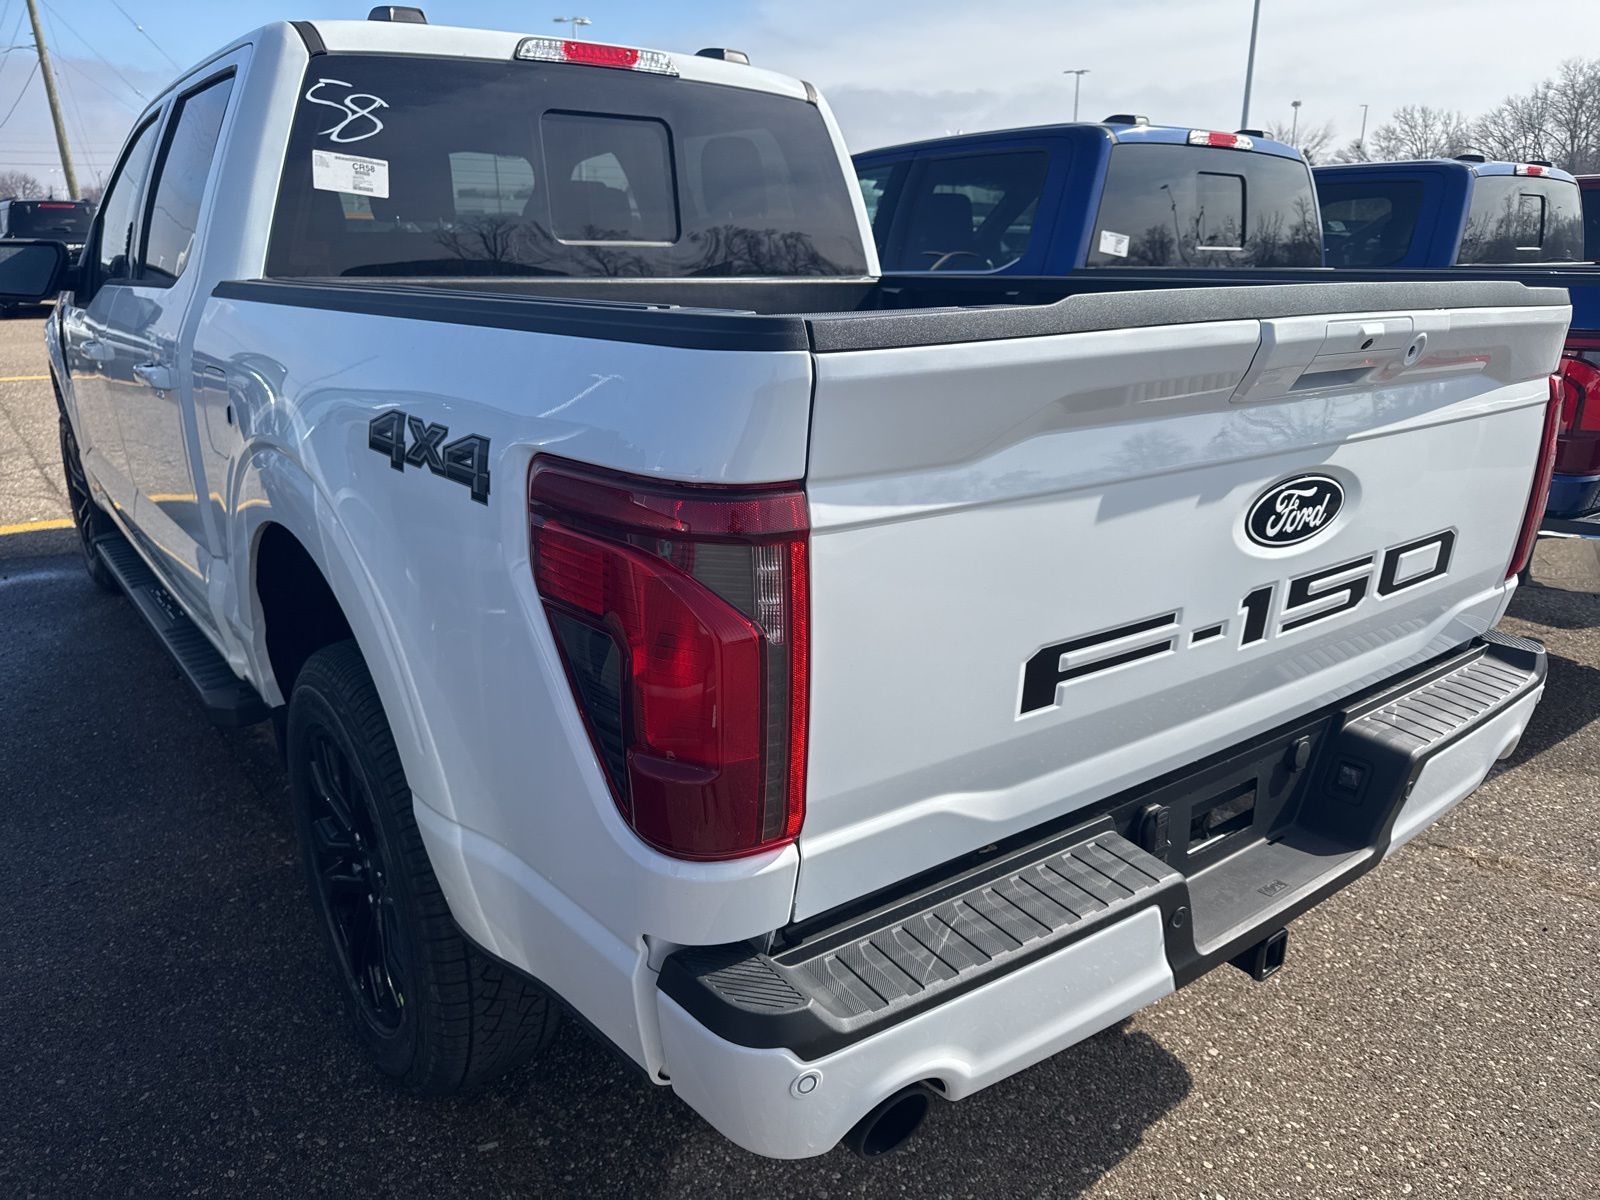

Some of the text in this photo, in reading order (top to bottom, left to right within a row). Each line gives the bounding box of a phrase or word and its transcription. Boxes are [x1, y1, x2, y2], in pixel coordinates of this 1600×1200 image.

[305, 78, 390, 143] 58
[352, 162, 376, 173] CR58
[1265, 486, 1331, 537] Ford
[1015, 526, 1458, 721] F-150
